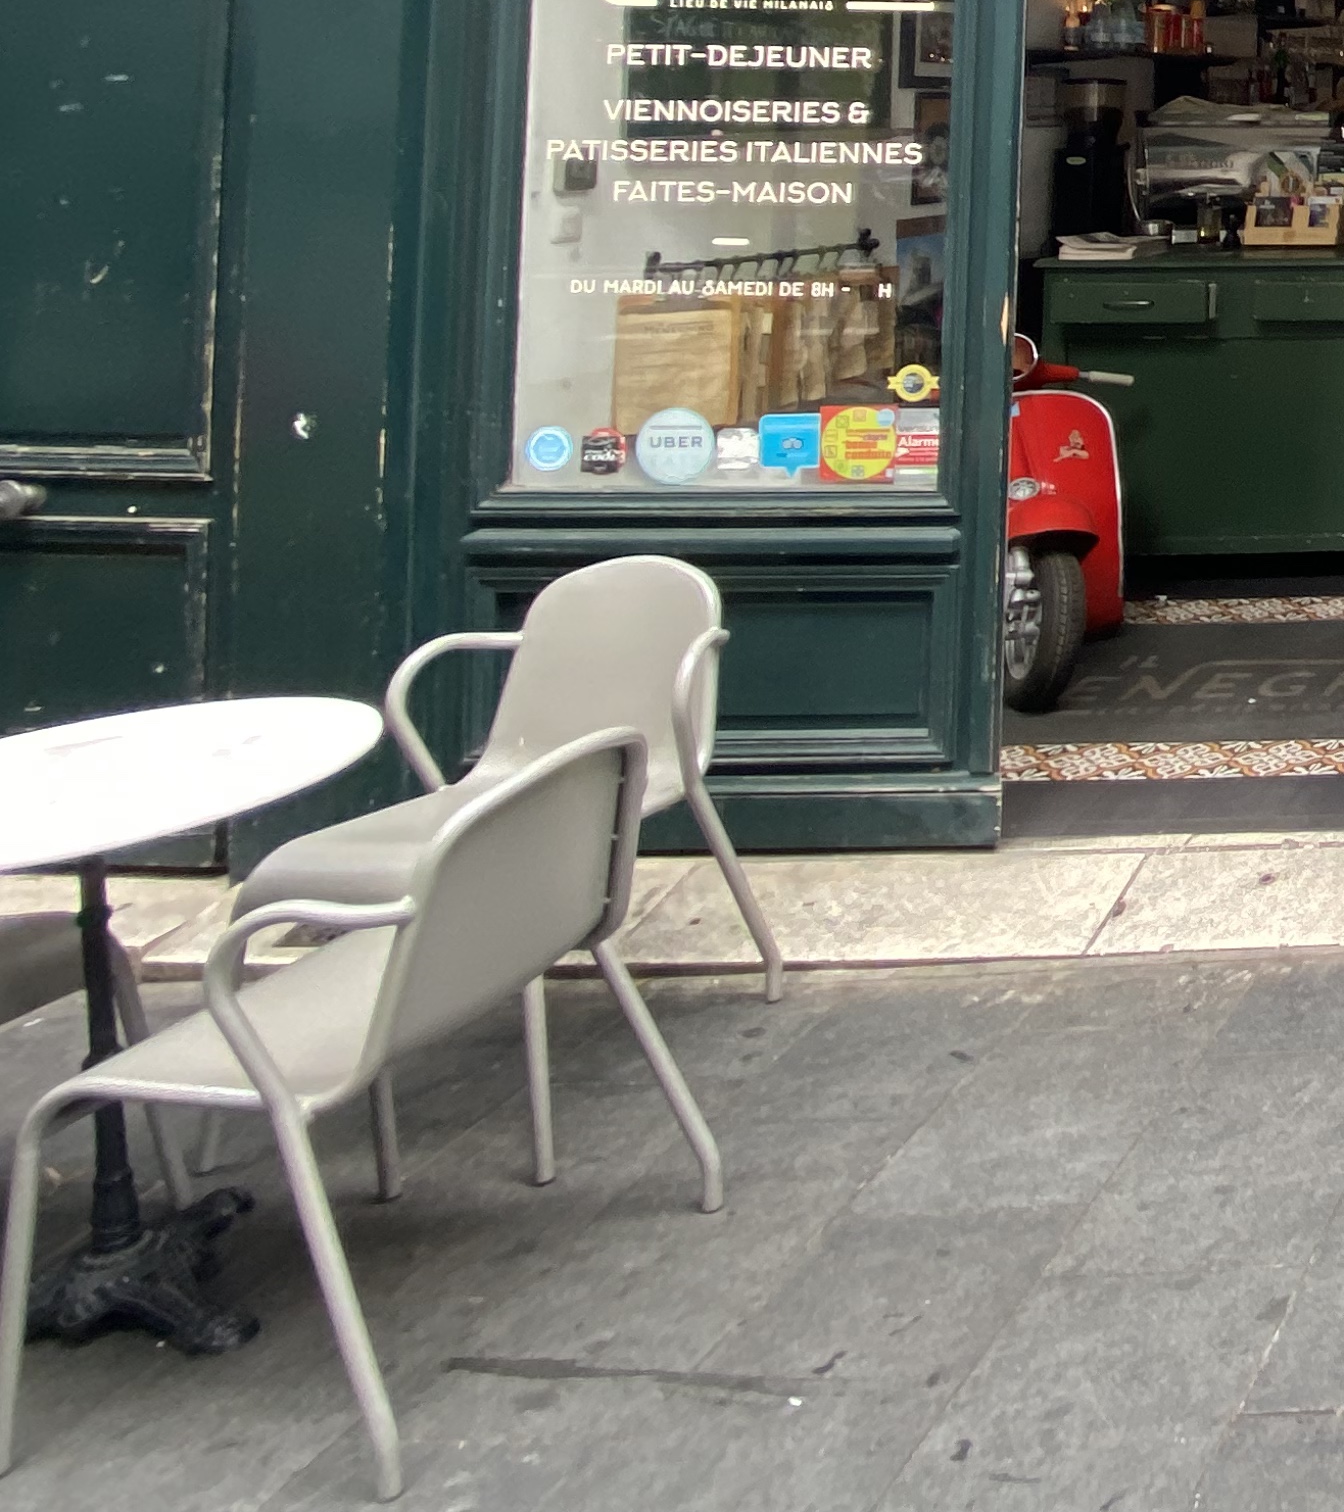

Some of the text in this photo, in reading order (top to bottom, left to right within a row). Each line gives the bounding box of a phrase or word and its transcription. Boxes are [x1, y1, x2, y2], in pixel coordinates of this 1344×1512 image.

[669, 0, 833, 11] LIEU DE VIE MILANAIS
[607, 44, 872, 69] PETIT-DEJEUNER
[604, 99, 870, 124] VIENNOISERIES &
[546, 139, 924, 165] PATISSERIES ITALIENNES
[613, 180, 853, 205] FAITES-MAISON
[570, 279, 596, 294] DU
[604, 280, 663, 295] MARDI
[668, 281, 695, 296] AU
[702, 281, 773, 297] SAMEDI
[779, 282, 804, 297] DE
[811, 282, 834, 298] 8H
[650, 436, 703, 448] UBER
